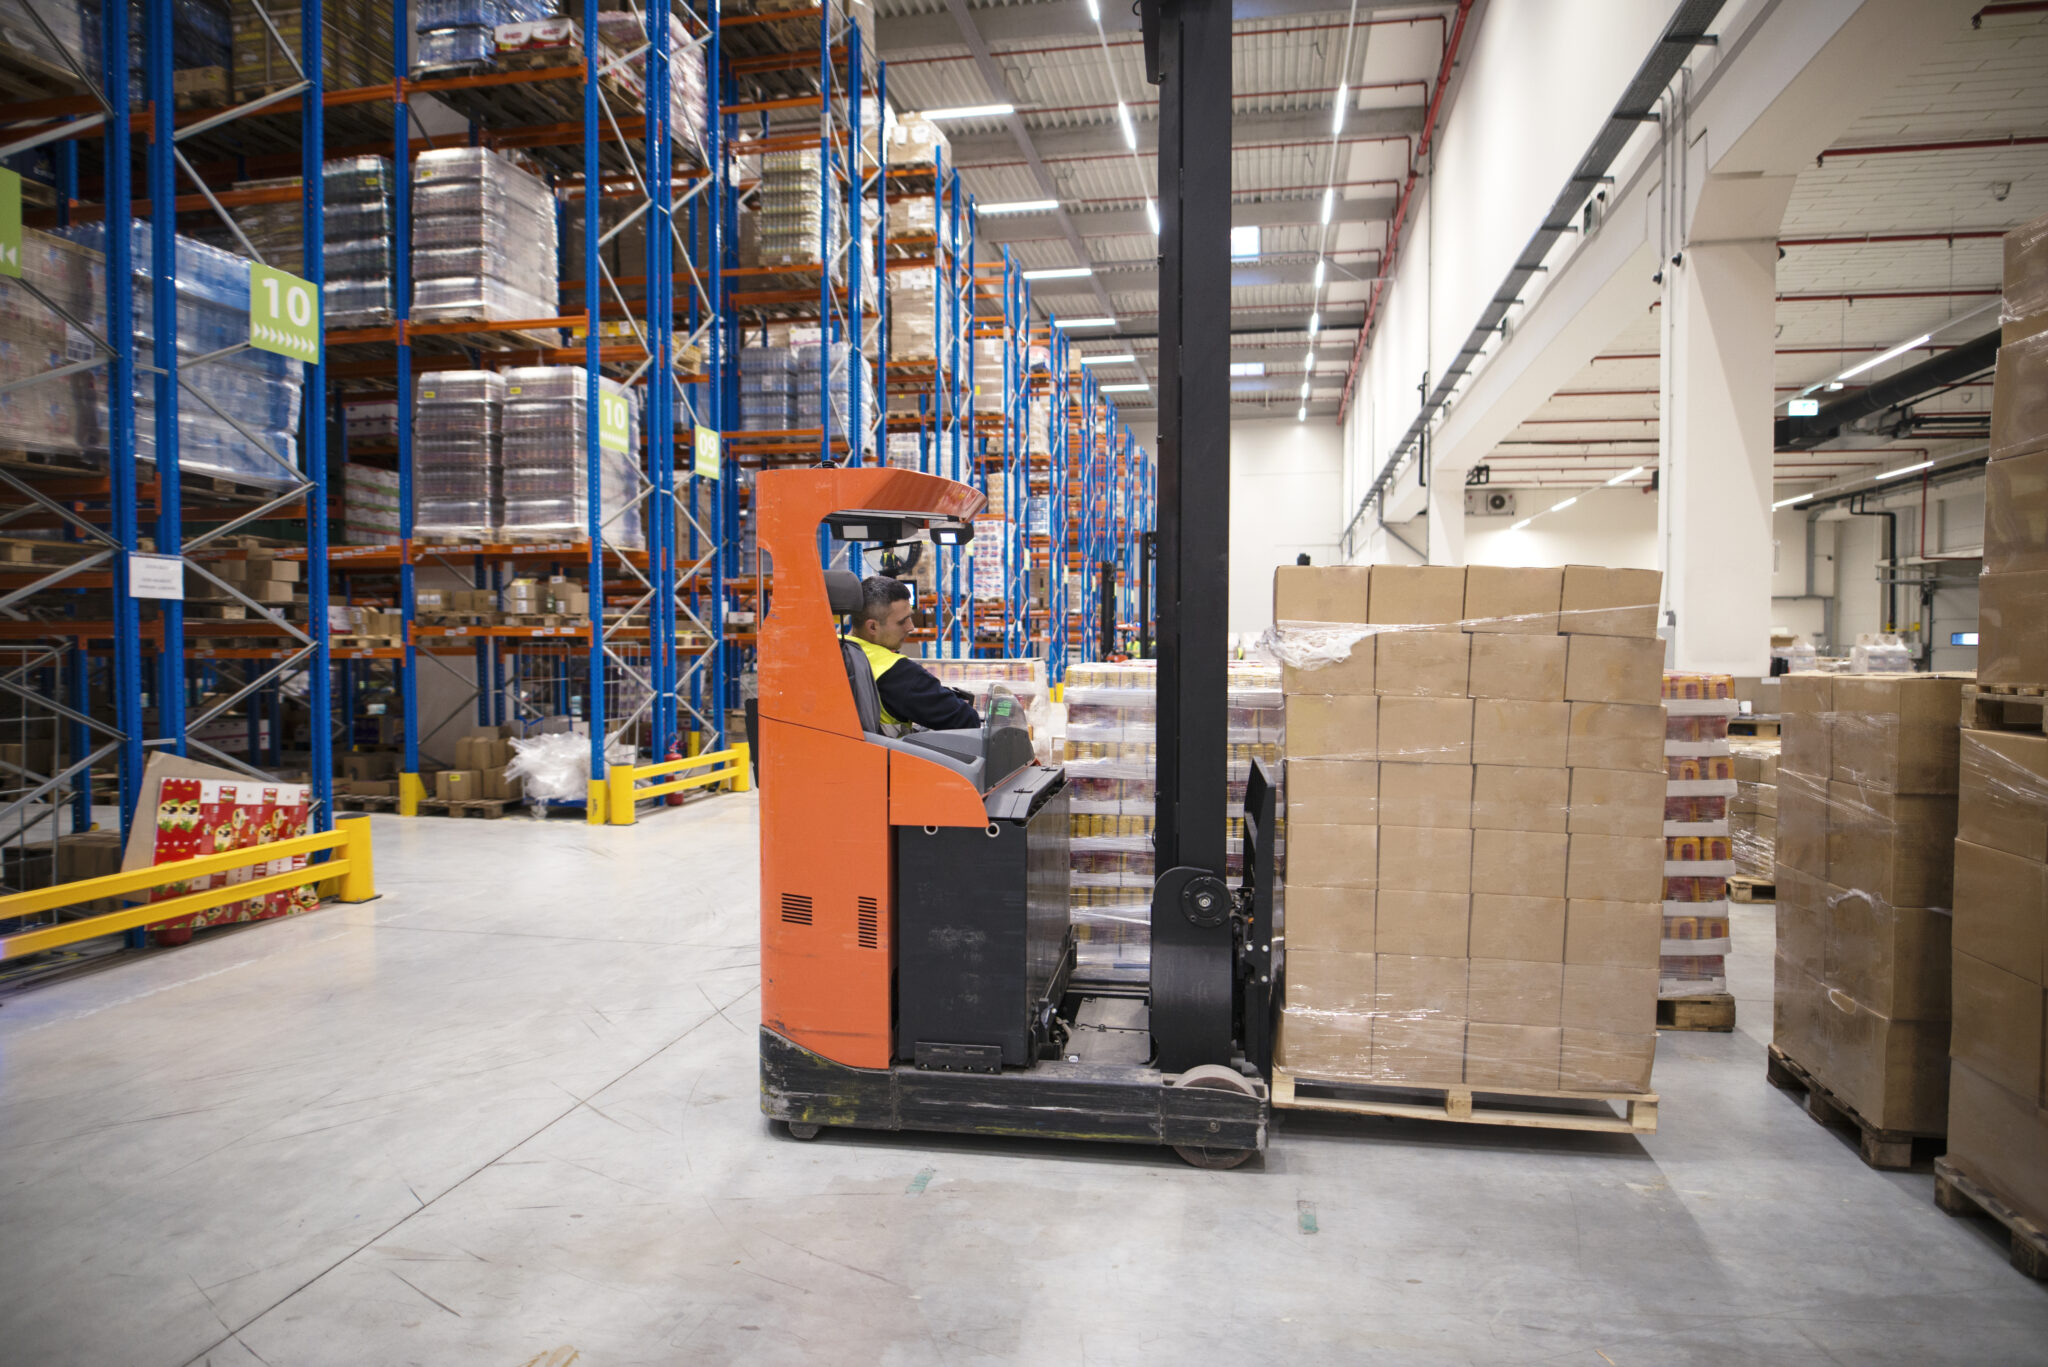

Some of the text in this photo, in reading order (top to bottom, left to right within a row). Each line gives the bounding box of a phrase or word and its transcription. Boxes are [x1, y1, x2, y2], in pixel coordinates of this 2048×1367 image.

[262, 278, 311, 327] 10
[603, 398, 625, 430] 10
[699, 432, 717, 458] 09
